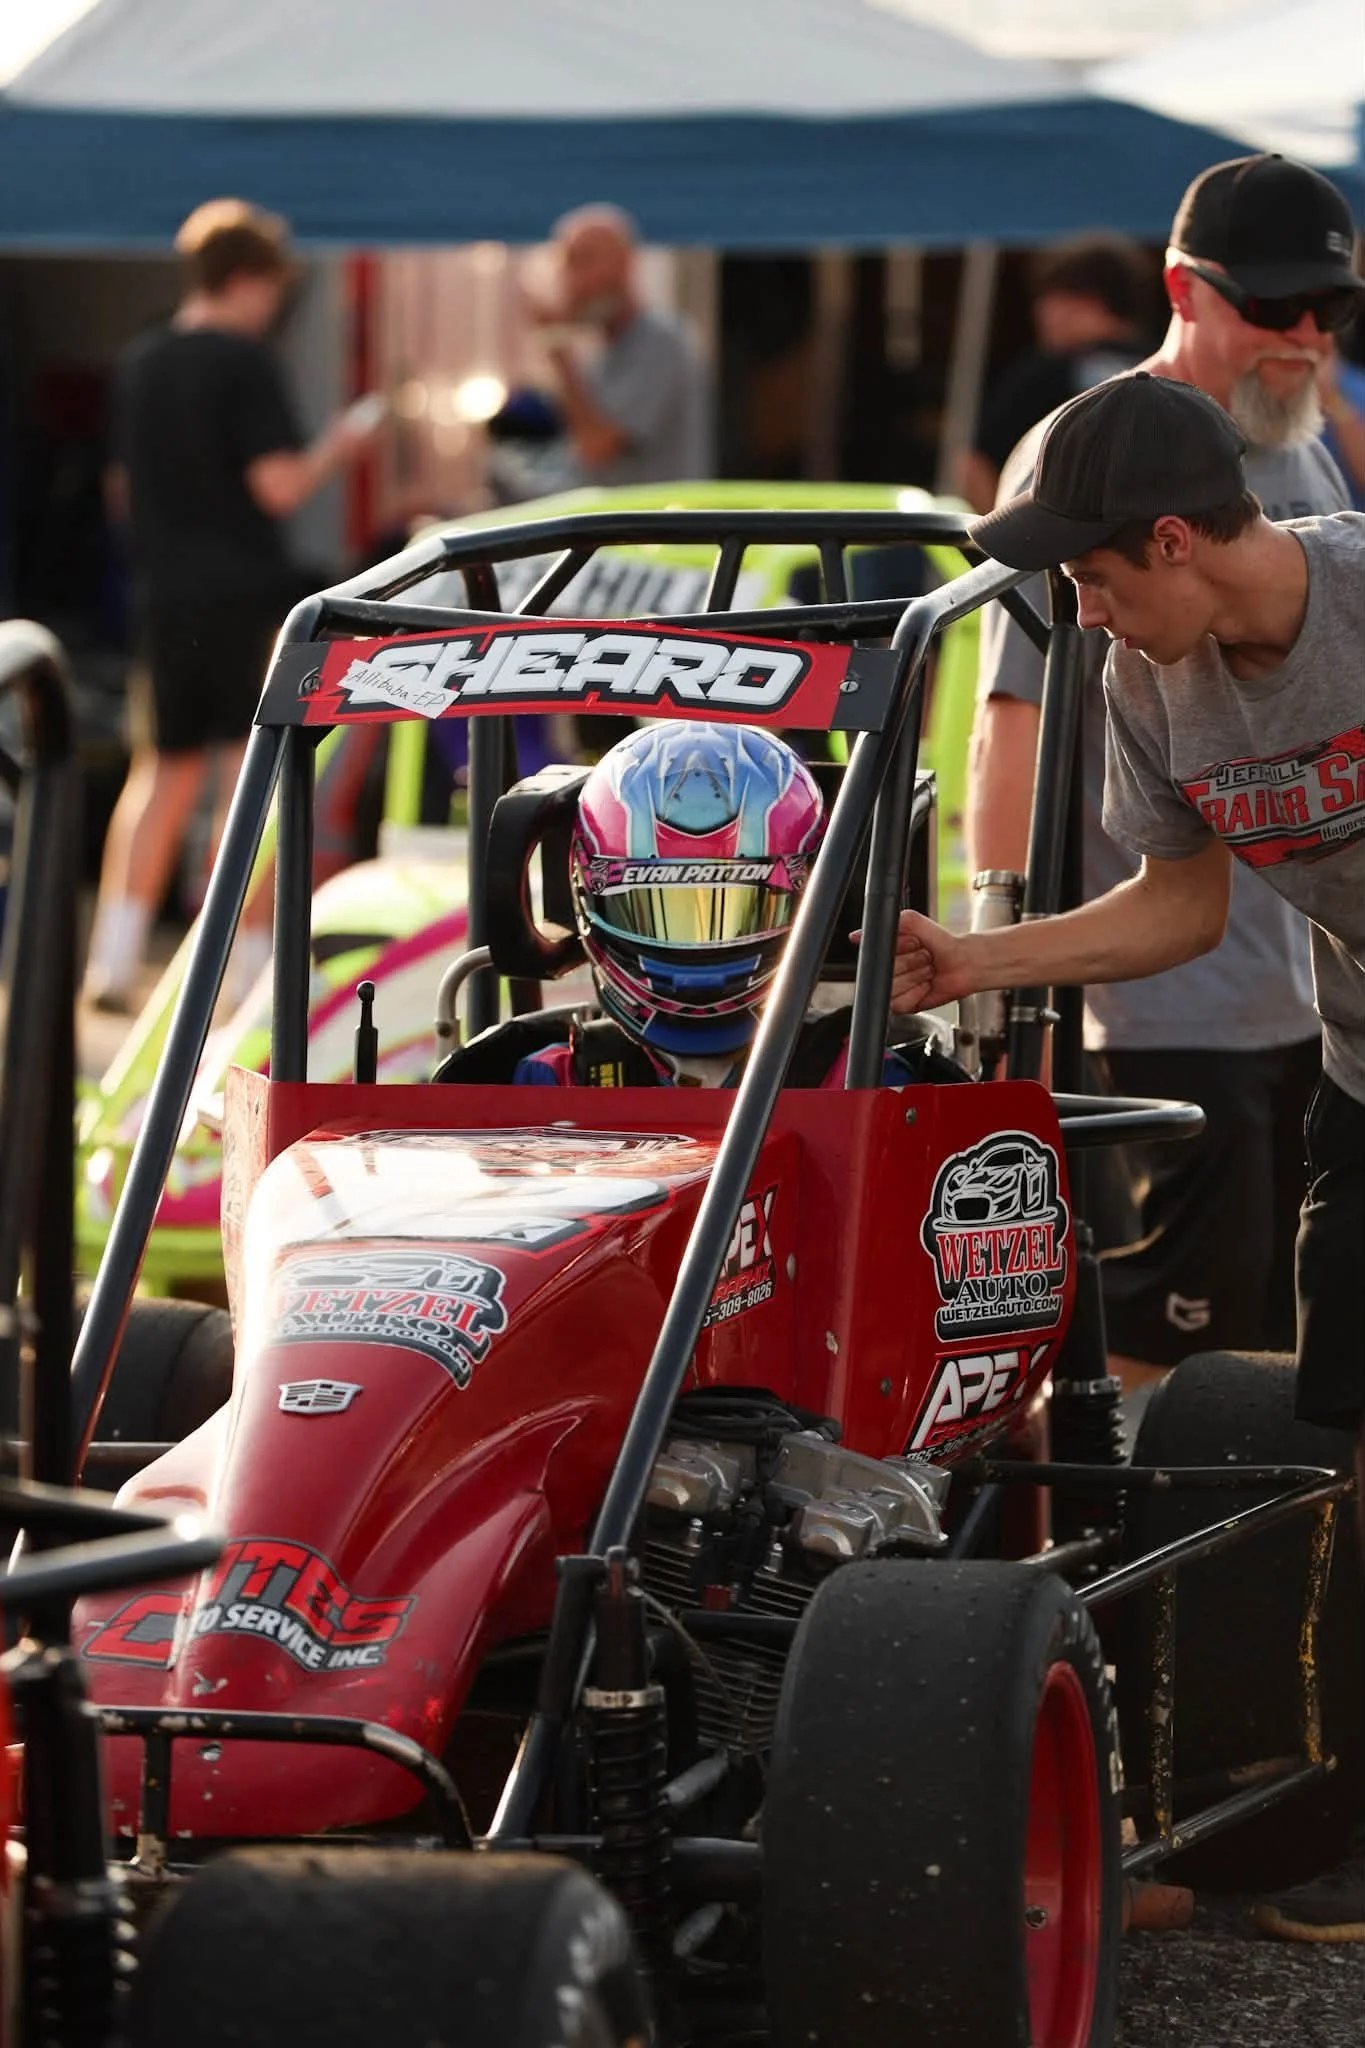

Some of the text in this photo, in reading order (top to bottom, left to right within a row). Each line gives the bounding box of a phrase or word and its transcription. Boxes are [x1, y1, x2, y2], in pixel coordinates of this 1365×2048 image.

[622, 864, 775, 883] EVAN PATTON
[936, 1223, 1063, 1283] WETZEL
[951, 1271, 1049, 1307] AUTO
[941, 1296, 1060, 1324] WETZELAUTO.COM
[221, 1602, 326, 1669] SERVICE
